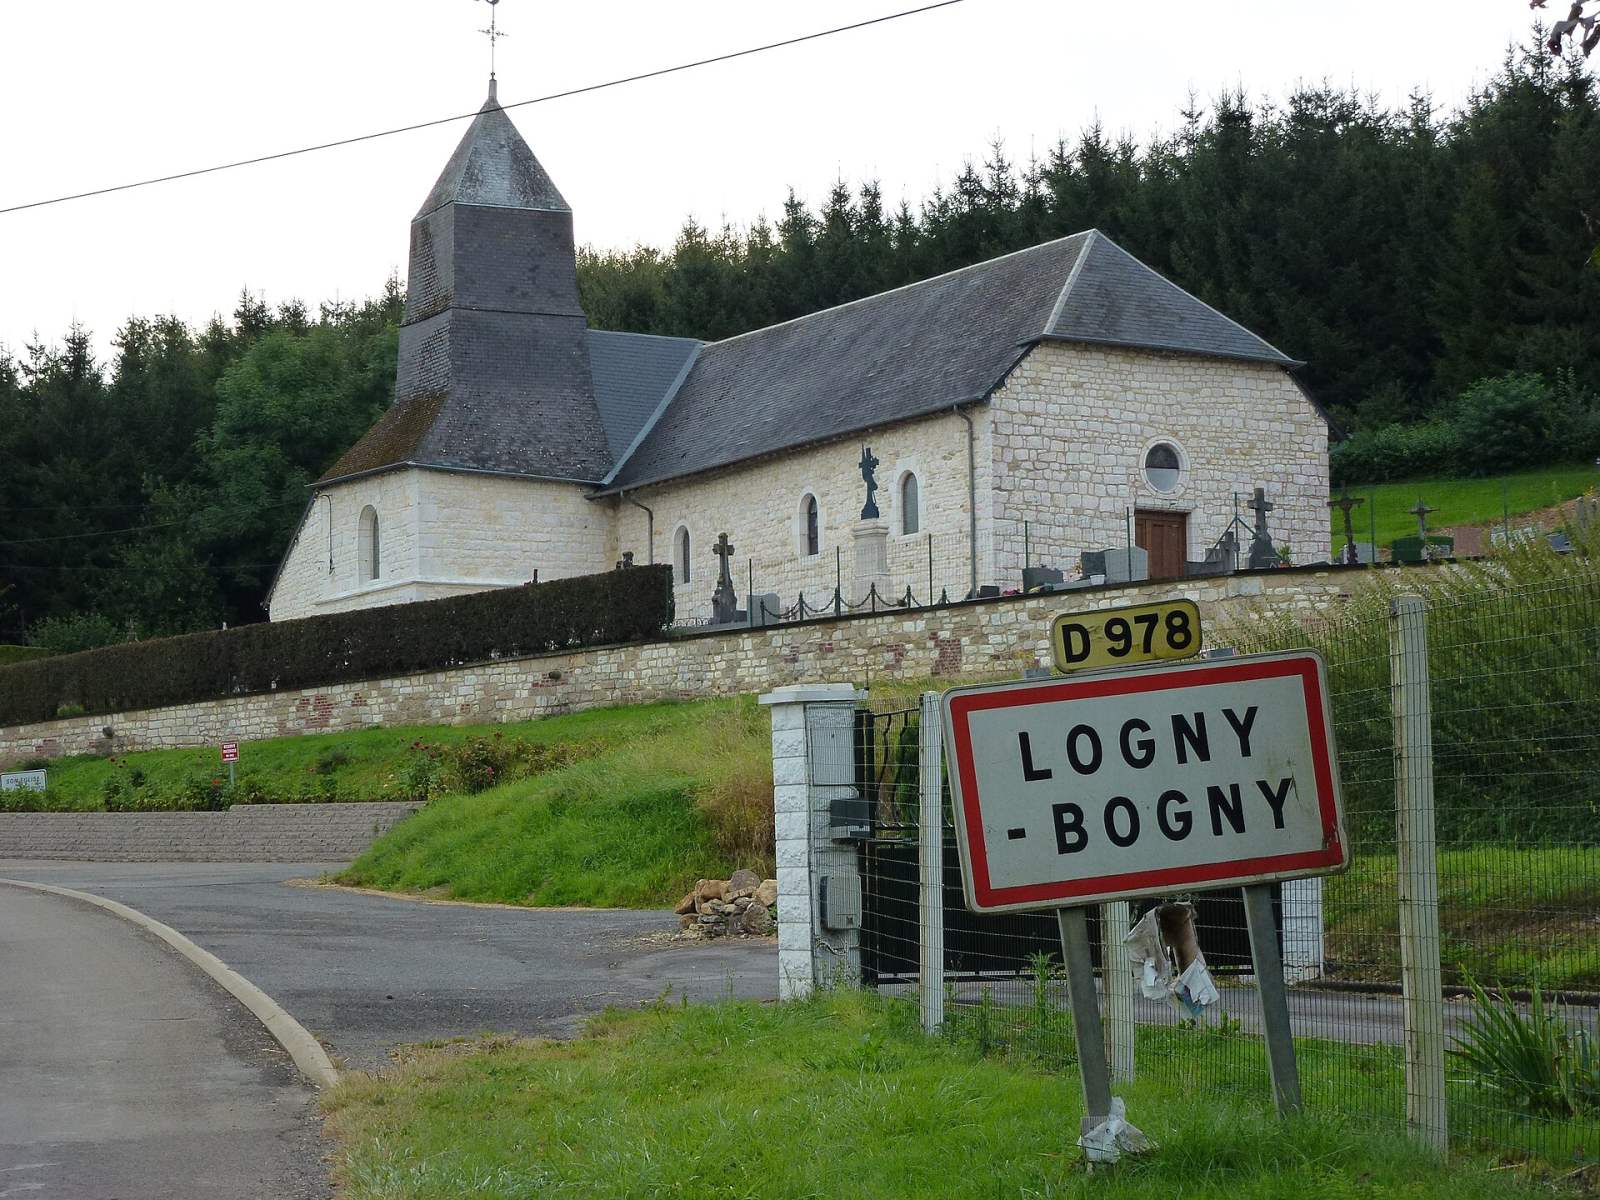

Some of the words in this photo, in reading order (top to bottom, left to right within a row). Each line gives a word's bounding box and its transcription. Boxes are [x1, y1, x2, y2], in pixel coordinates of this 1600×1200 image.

[1061, 622, 1092, 664] D
[1103, 609, 1193, 658] 978
[1018, 705, 1259, 782] LOGNY
